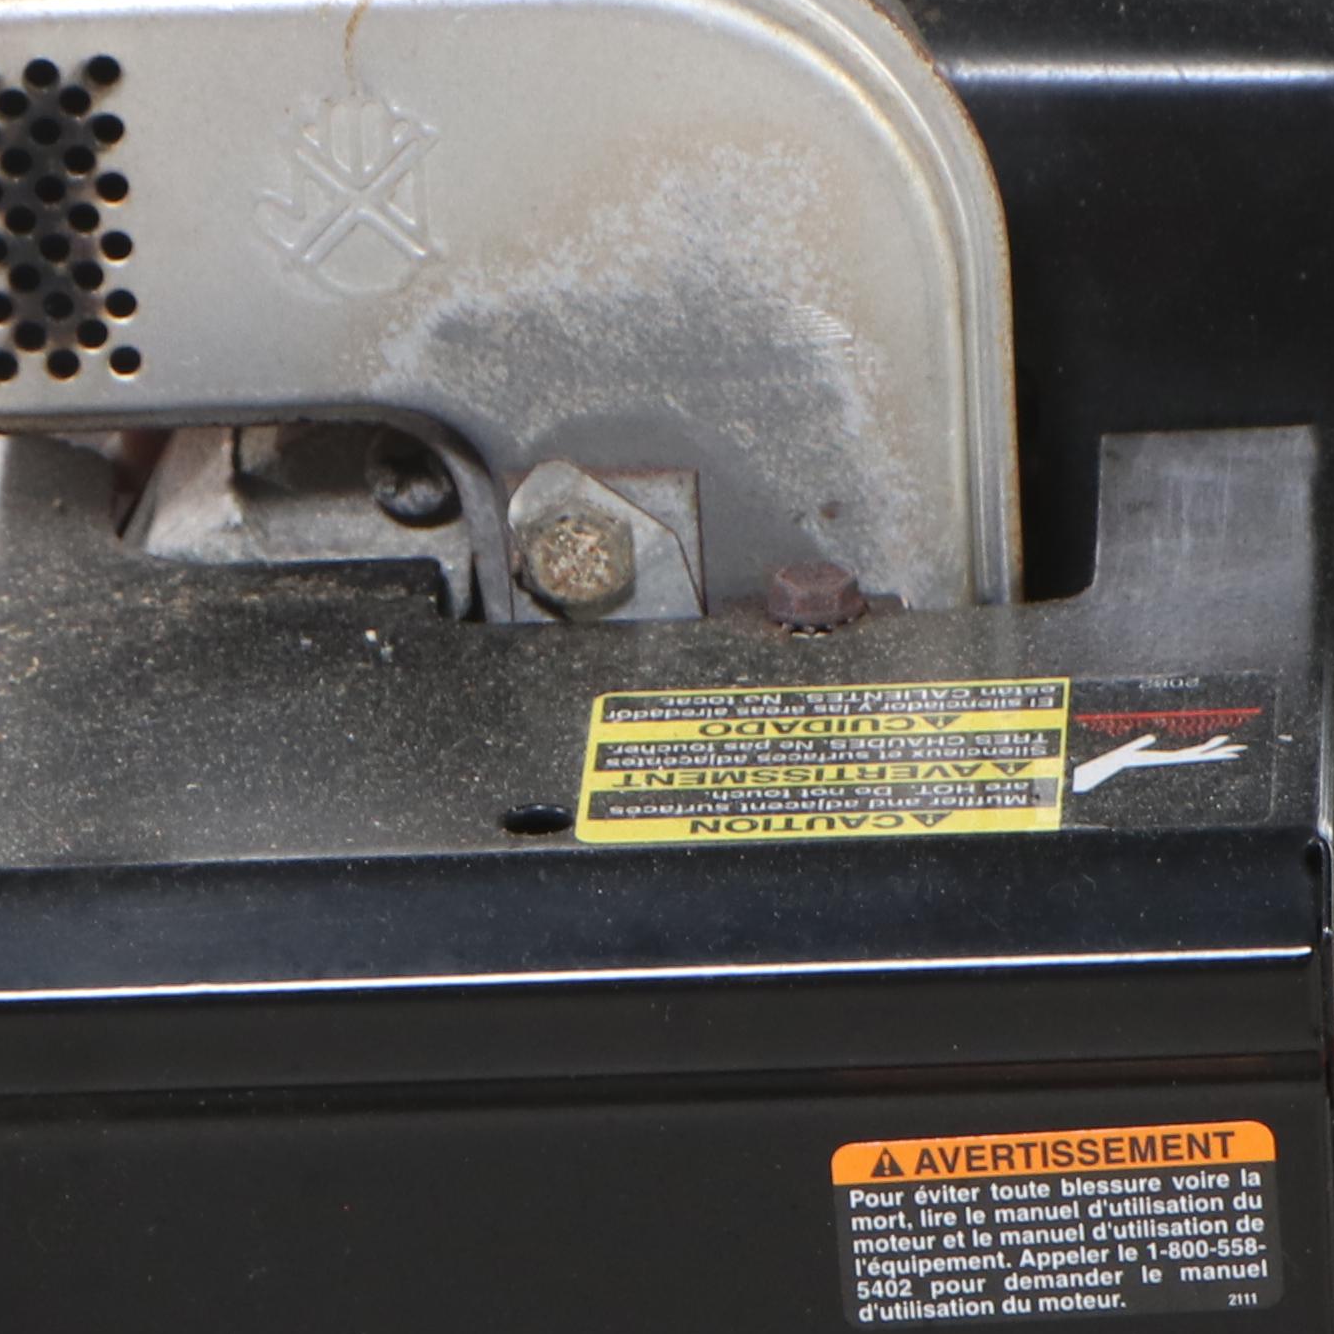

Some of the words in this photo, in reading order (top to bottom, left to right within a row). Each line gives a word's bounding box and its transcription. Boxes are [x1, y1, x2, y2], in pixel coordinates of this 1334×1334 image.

[743, 693, 782, 705] No
[800, 687, 970, 704] CALIENTES.
[1029, 697, 1055, 708] El
[813, 703, 850, 715] las
[880, 698, 1022, 712] silenciador
[698, 717, 916, 736] CUIDADO
[608, 741, 715, 755] toucher.
[723, 739, 770, 751] pas
[779, 740, 814, 752] Ne
[824, 734, 965, 750] CHAUDES.
[757, 749, 869, 764] surfaces
[880, 747, 902, 759] et
[912, 745, 1047, 758] Silencieux
[606, 753, 748, 768] adjacentes
[612, 762, 983, 787] AVERTISSMENT
[800, 786, 845, 798] not
[855, 785, 892, 797] Do
[911, 783, 975, 795] HOT.
[985, 781, 1029, 792] are
[706, 788, 791, 800] touch.
[929, 794, 1027, 807] Muffler
[609, 800, 732, 815] surfaces
[741, 797, 859, 814] adjacent
[869, 796, 922, 810] and
[689, 814, 904, 834] CAUTION
[914, 1131, 1235, 1175] AVERTISSEMENT
[849, 1189, 905, 1209] Pour
[914, 1185, 981, 1205] éviter
[990, 1181, 1051, 1202] toute
[1061, 1176, 1162, 1198] blessure
[1172, 1170, 1230, 1191] voire
[1240, 1168, 1261, 1187] la
[851, 1210, 913, 1231] mort,
[920, 1208, 957, 1228] lire
[965, 1206, 986, 1225] le
[994, 1200, 1080, 1224] manuel
[1087, 1193, 1224, 1218] d'utilisation
[1232, 1191, 1263, 1211] du
[853, 1235, 936, 1254] moteur
[942, 1230, 966, 1249] et
[972, 1229, 993, 1248] le
[1000, 1223, 1085, 1247] manuel
[1092, 1216, 1228, 1242] d'utilisation
[1235, 1214, 1265, 1234] de
[855, 1251, 1012, 1280] l'équipement.
[1019, 1245, 1110, 1271] Appeler
[1117, 1243, 1139, 1263] le
[1146, 1237, 1267, 1261] 1-800-558-
[857, 1278, 913, 1300] 5402
[930, 1277, 986, 1300] pour
[1003, 1267, 1123, 1292] demander
[1141, 1264, 1163, 1284] le
[1180, 1258, 1268, 1282] manuel
[1228, 1292, 1258, 1306] 2111
[858, 1297, 995, 1323] d'utilisation
[1001, 1295, 1031, 1315] du
[1038, 1292, 1127, 1312] moteur.
